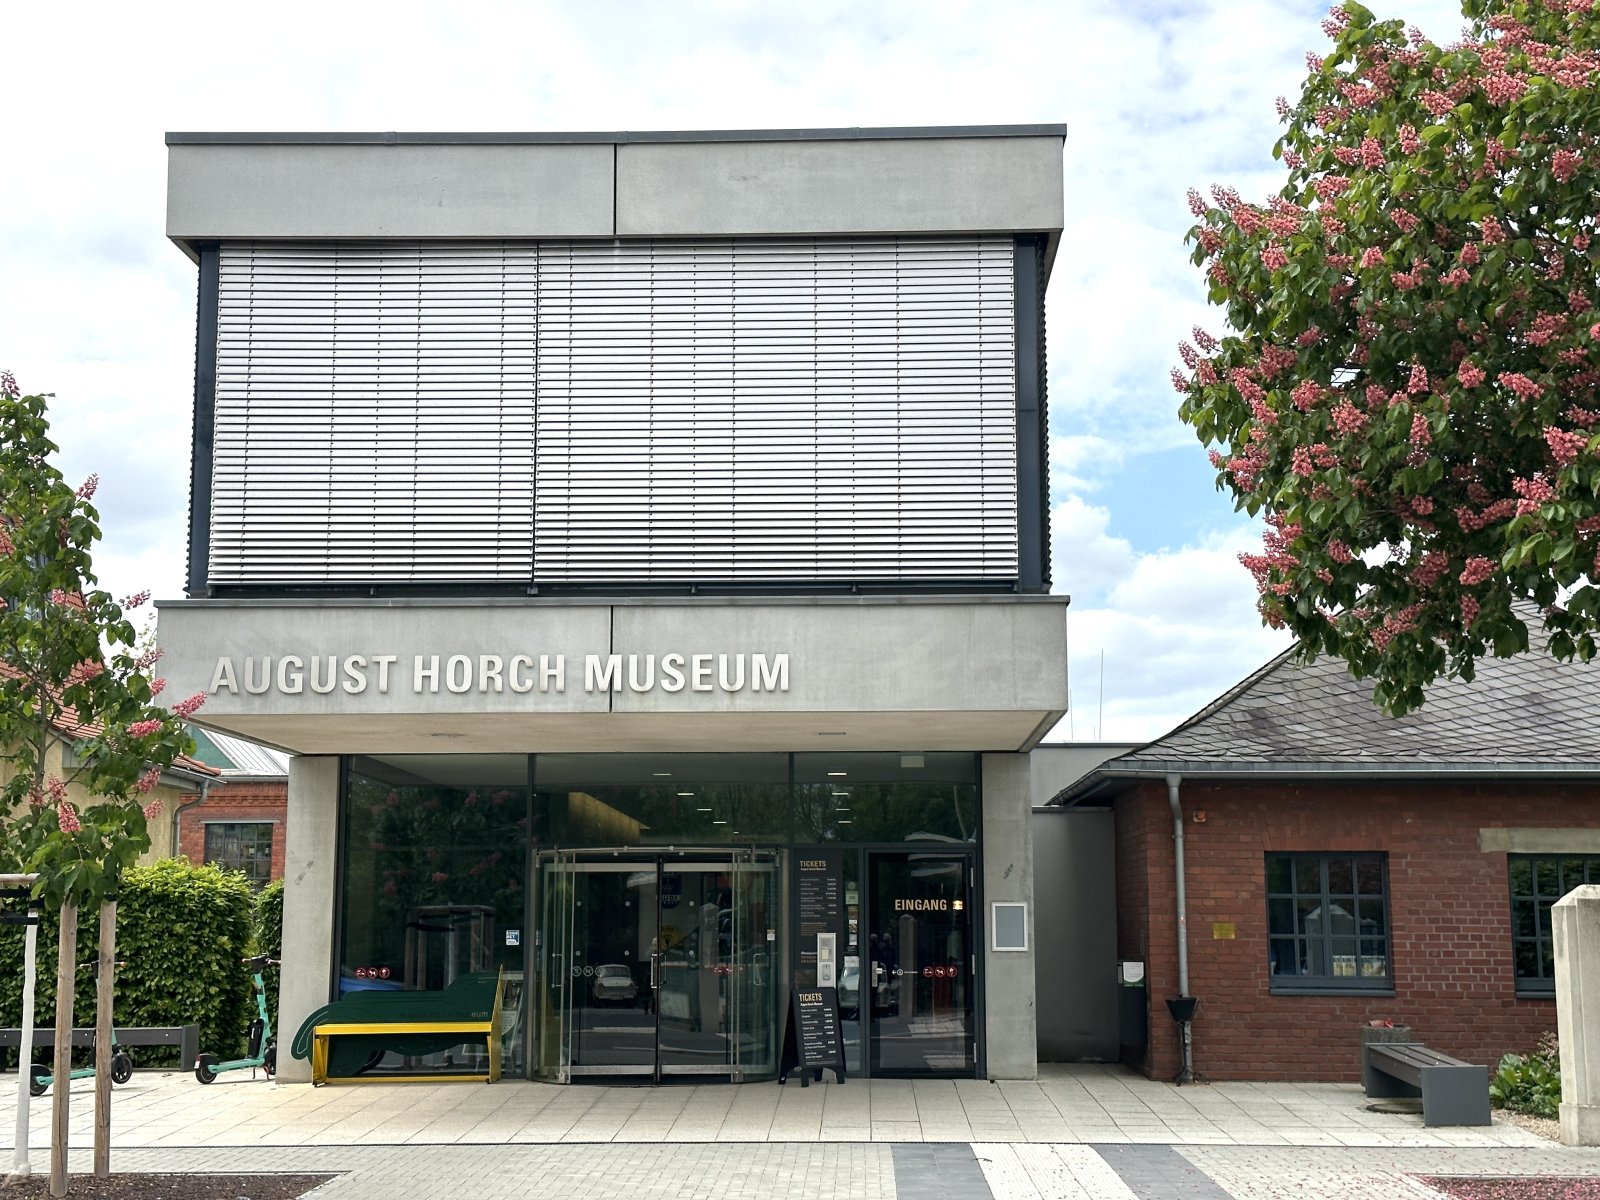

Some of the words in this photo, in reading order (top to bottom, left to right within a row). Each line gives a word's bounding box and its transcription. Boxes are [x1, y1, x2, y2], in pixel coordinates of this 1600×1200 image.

[208, 654, 397, 695] AUGUST
[413, 653, 565, 694] HORCH
[584, 652, 789, 692] MUSEUM
[894, 899, 947, 911] EINGANG
[798, 992, 823, 1002] TICKETS
